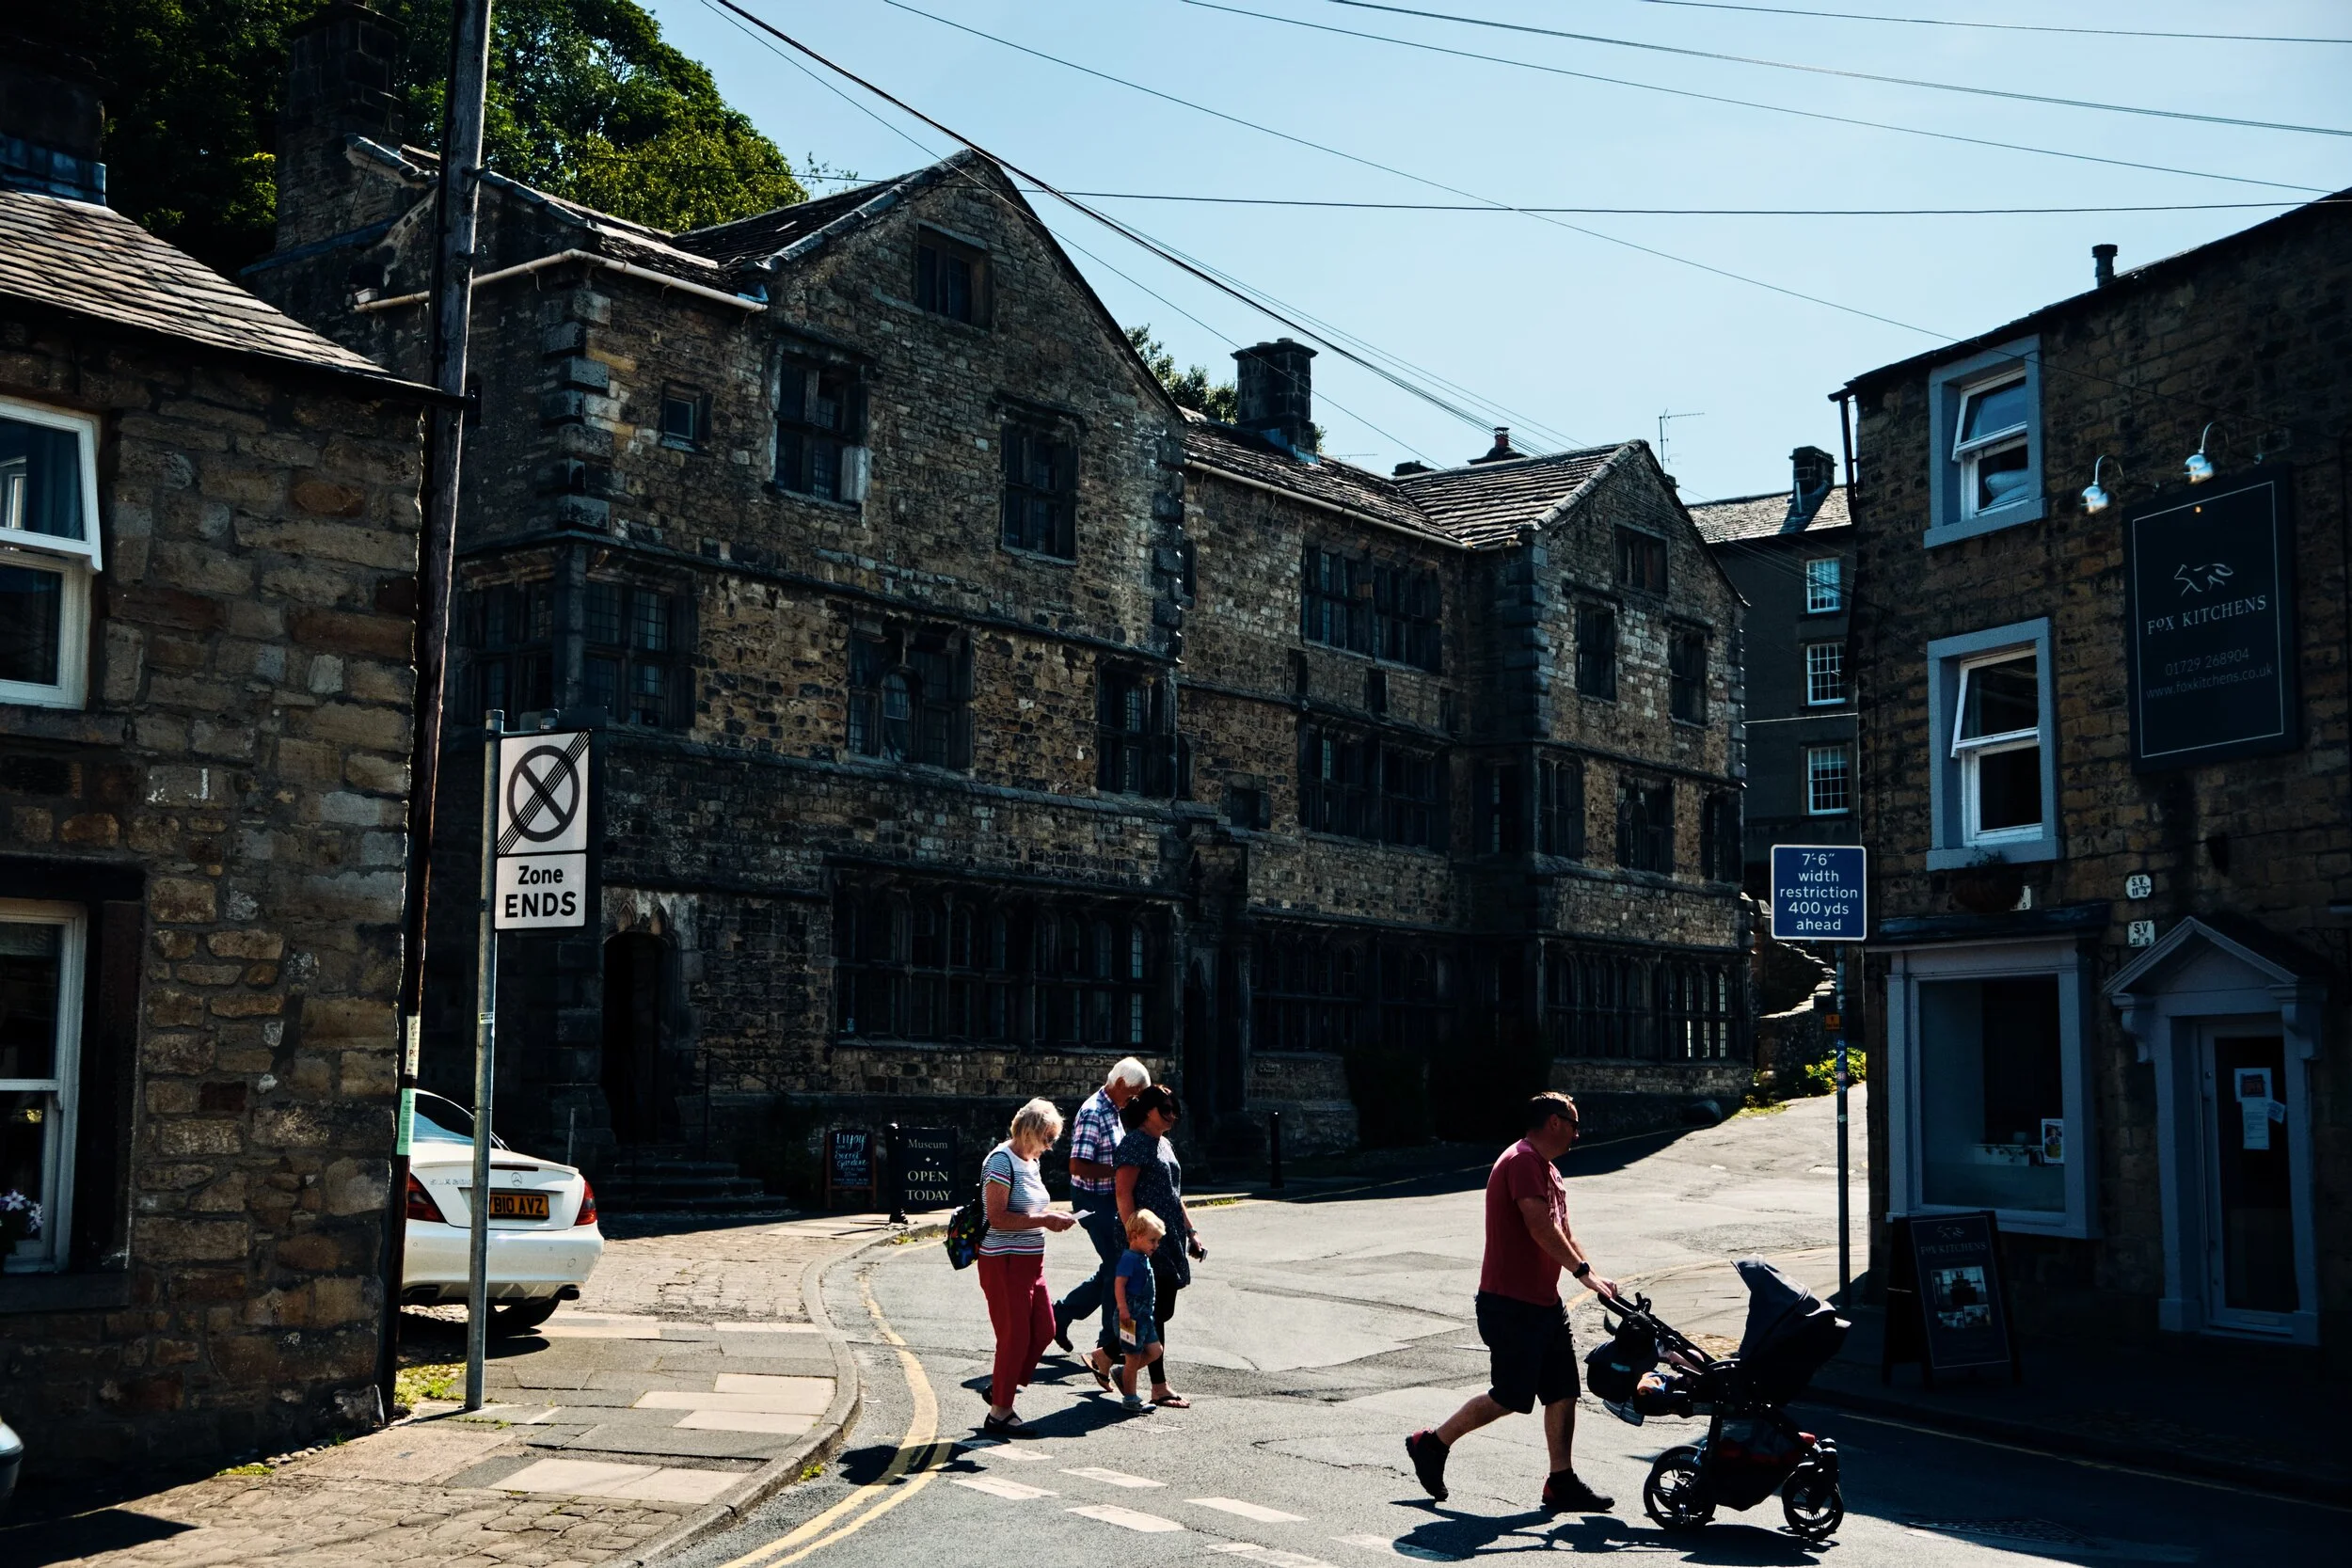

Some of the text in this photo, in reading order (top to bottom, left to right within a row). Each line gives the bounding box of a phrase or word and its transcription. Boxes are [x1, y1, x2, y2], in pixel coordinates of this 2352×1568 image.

[2146, 594, 2266, 635] FOX KITCHENS
[2165, 646, 2250, 676] 01729 268904
[2145, 661, 2274, 700] www.foxkitchens.co.uk
[517, 865, 564, 885] Zone
[1798, 869, 1839, 882] width
[1779, 885, 1858, 898] restriction
[505, 891, 576, 918] ENDS
[1788, 901, 1850, 917] 400 yds
[1796, 918, 1841, 930] ahead
[908, 1138, 948, 1149] Museum
[907, 1170, 949, 1182] OPEN
[904, 1189, 952, 1201] TODAY
[1938, 1241, 1988, 1254] KITCHENS
